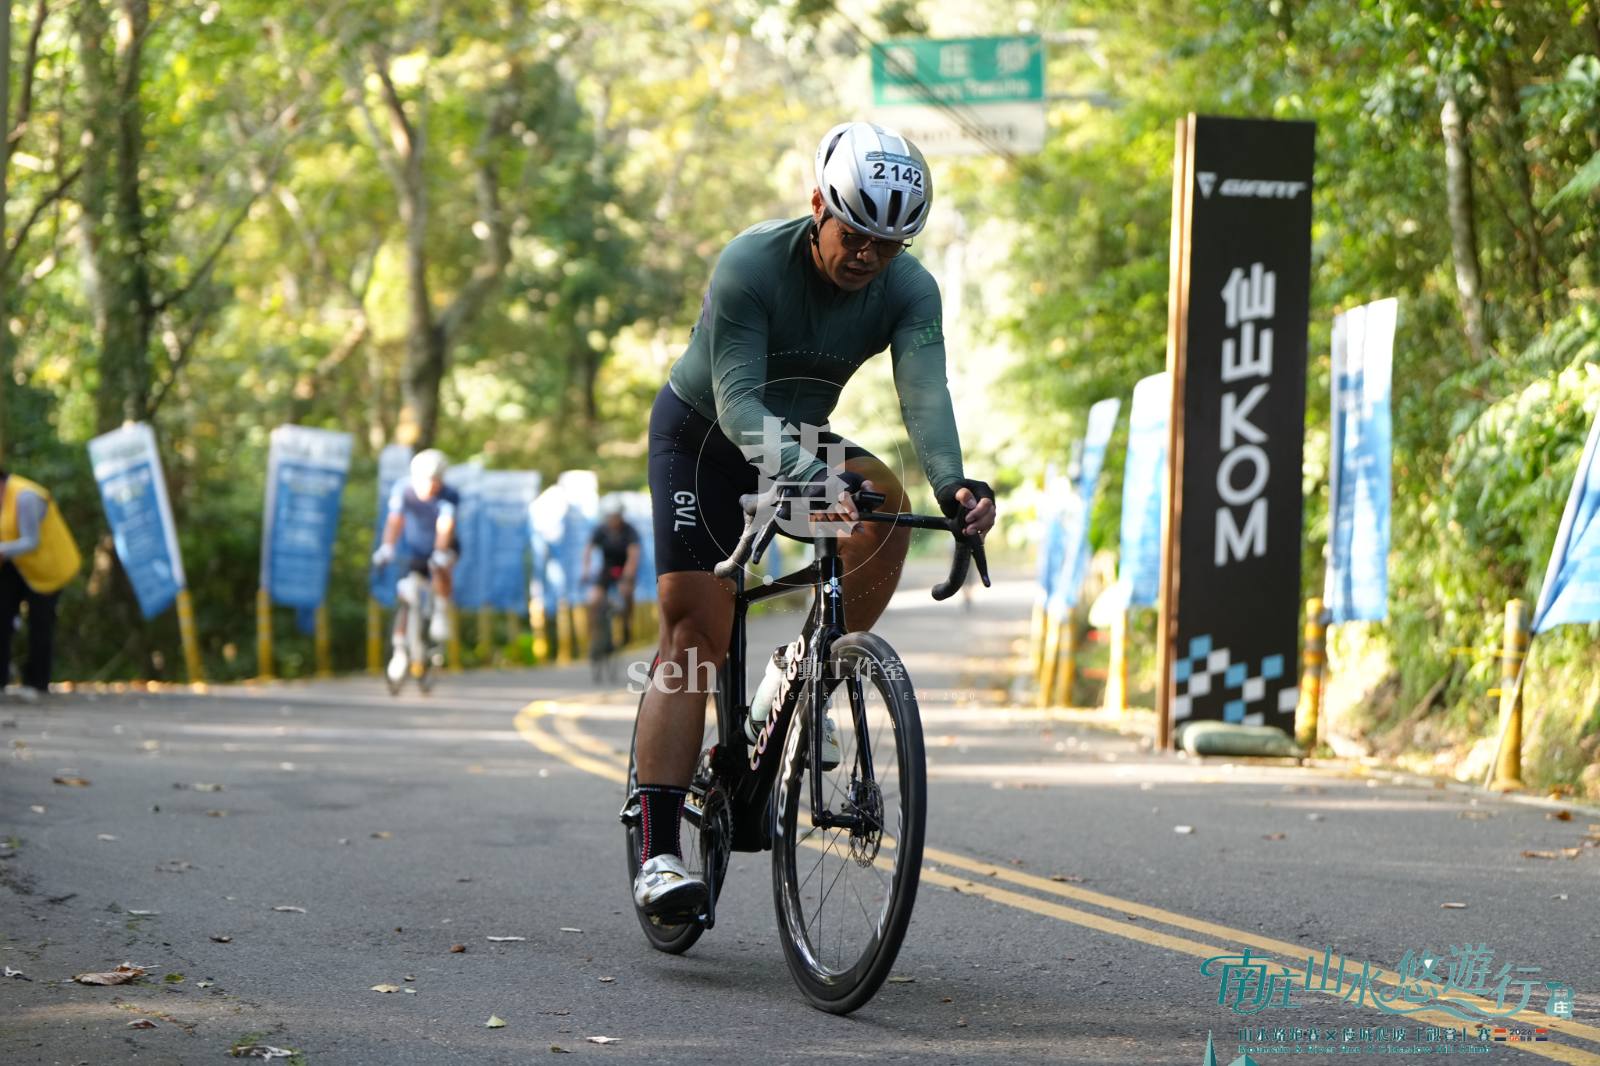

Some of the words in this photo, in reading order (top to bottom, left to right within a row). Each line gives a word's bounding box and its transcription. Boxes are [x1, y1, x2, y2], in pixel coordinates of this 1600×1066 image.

[873, 162, 923, 189] 2142
[673, 490, 696, 532] GVL
[750, 634, 806, 771] COLNAGO
